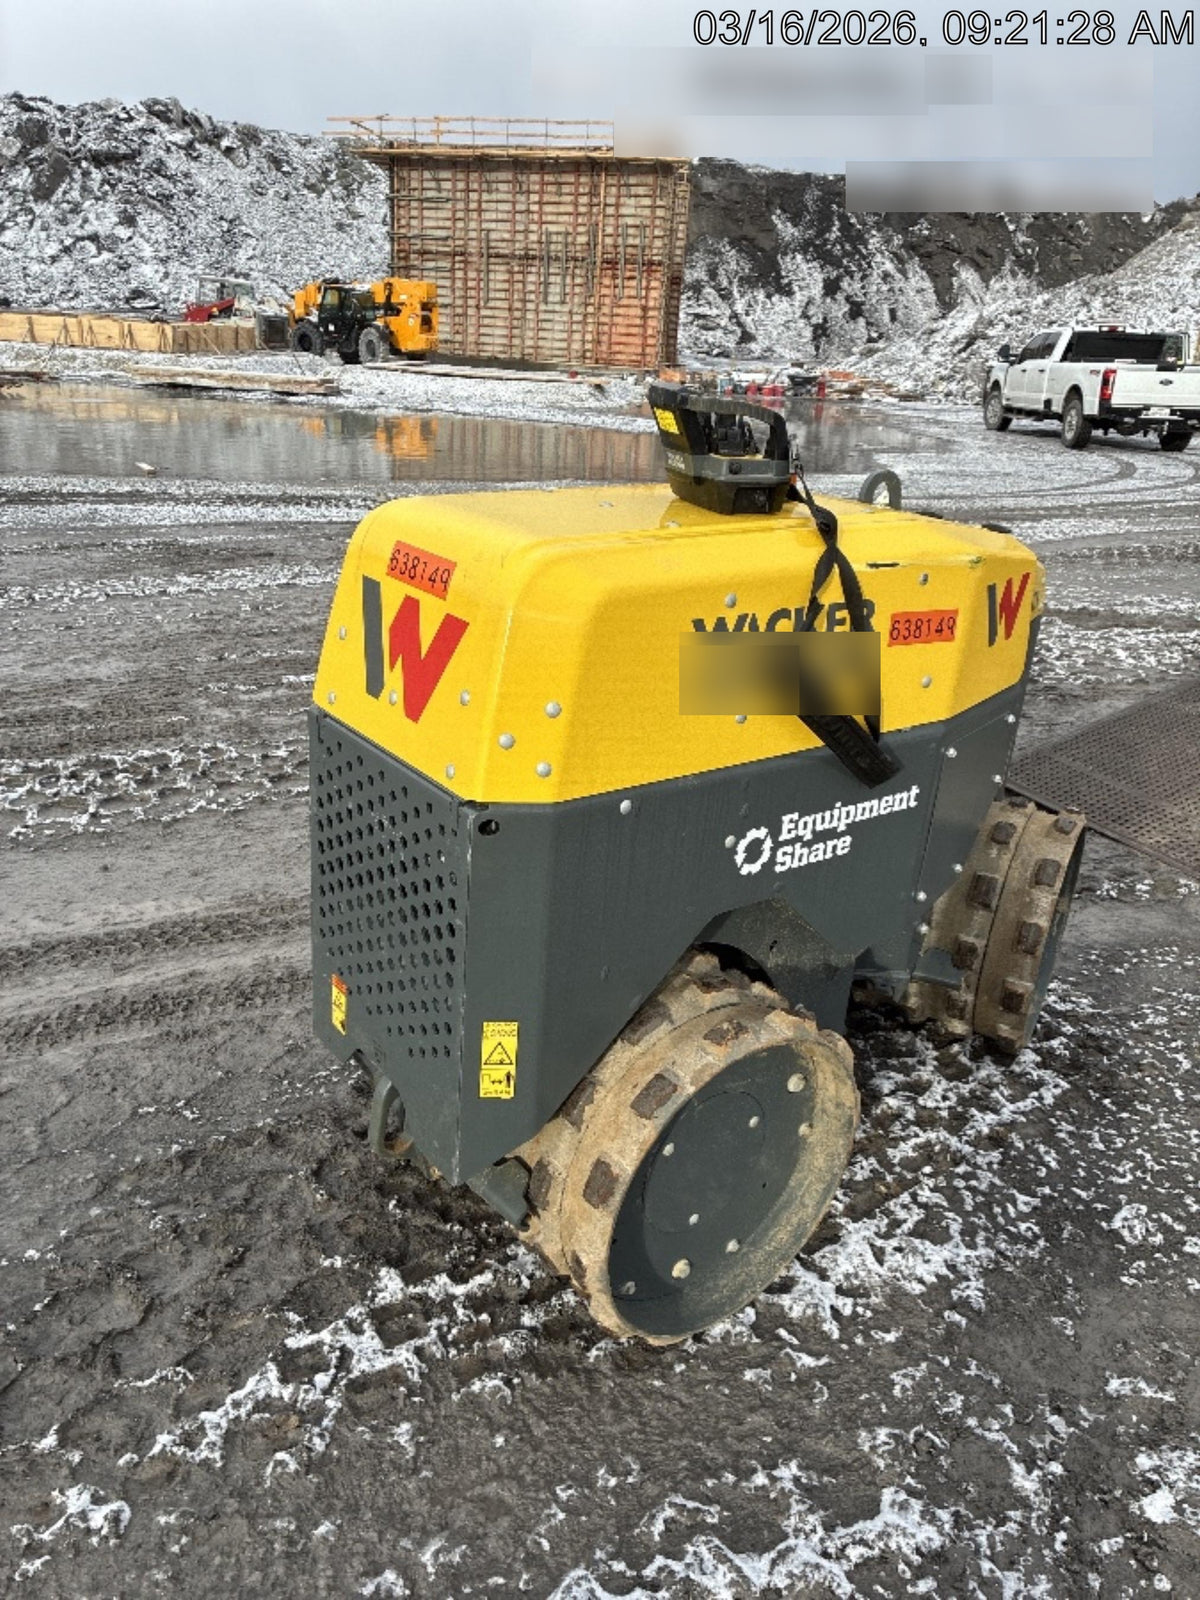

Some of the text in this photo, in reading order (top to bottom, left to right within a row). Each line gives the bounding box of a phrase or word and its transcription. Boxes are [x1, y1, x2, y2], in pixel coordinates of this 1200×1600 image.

[389, 548, 451, 593] 638149
[890, 616, 956, 641] 638149
[777, 784, 920, 842] Equipment
[774, 835, 853, 874] Share
